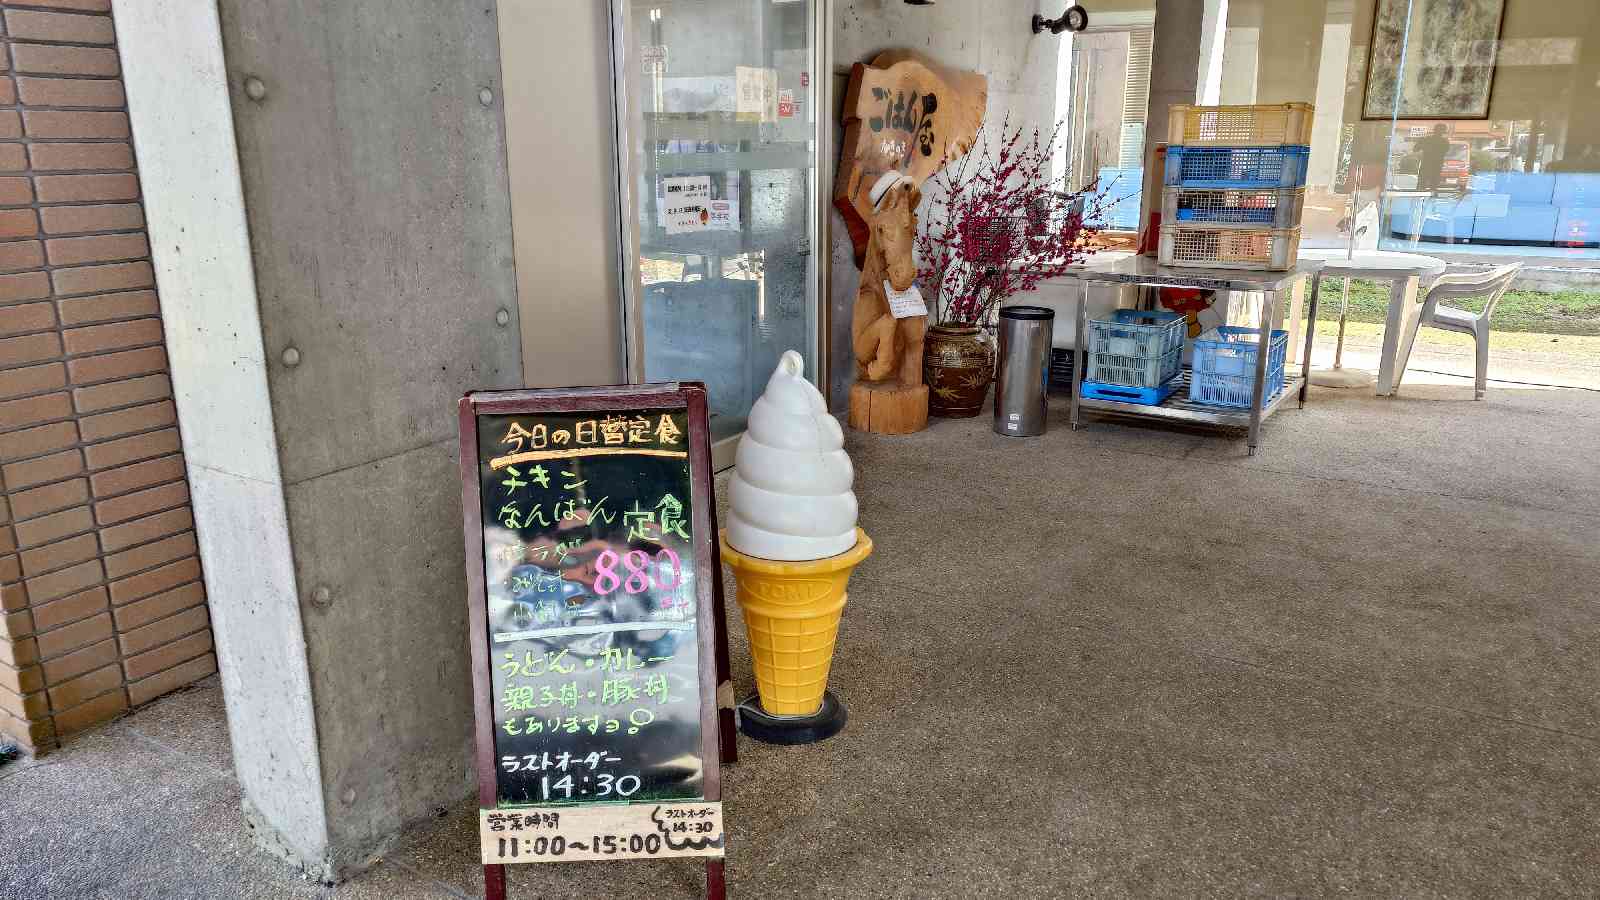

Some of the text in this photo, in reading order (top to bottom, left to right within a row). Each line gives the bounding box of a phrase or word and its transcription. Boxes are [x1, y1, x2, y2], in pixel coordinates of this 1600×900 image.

[501, 413, 682, 455] 今日の日替定食
[501, 464, 588, 496] チキン
[593, 549, 682, 595] 880
[502, 751, 622, 771] ラストオーダー
[541, 774, 641, 800] 14:30
[487, 812, 560, 832] 営業時間
[673, 821, 714, 834] 14:30
